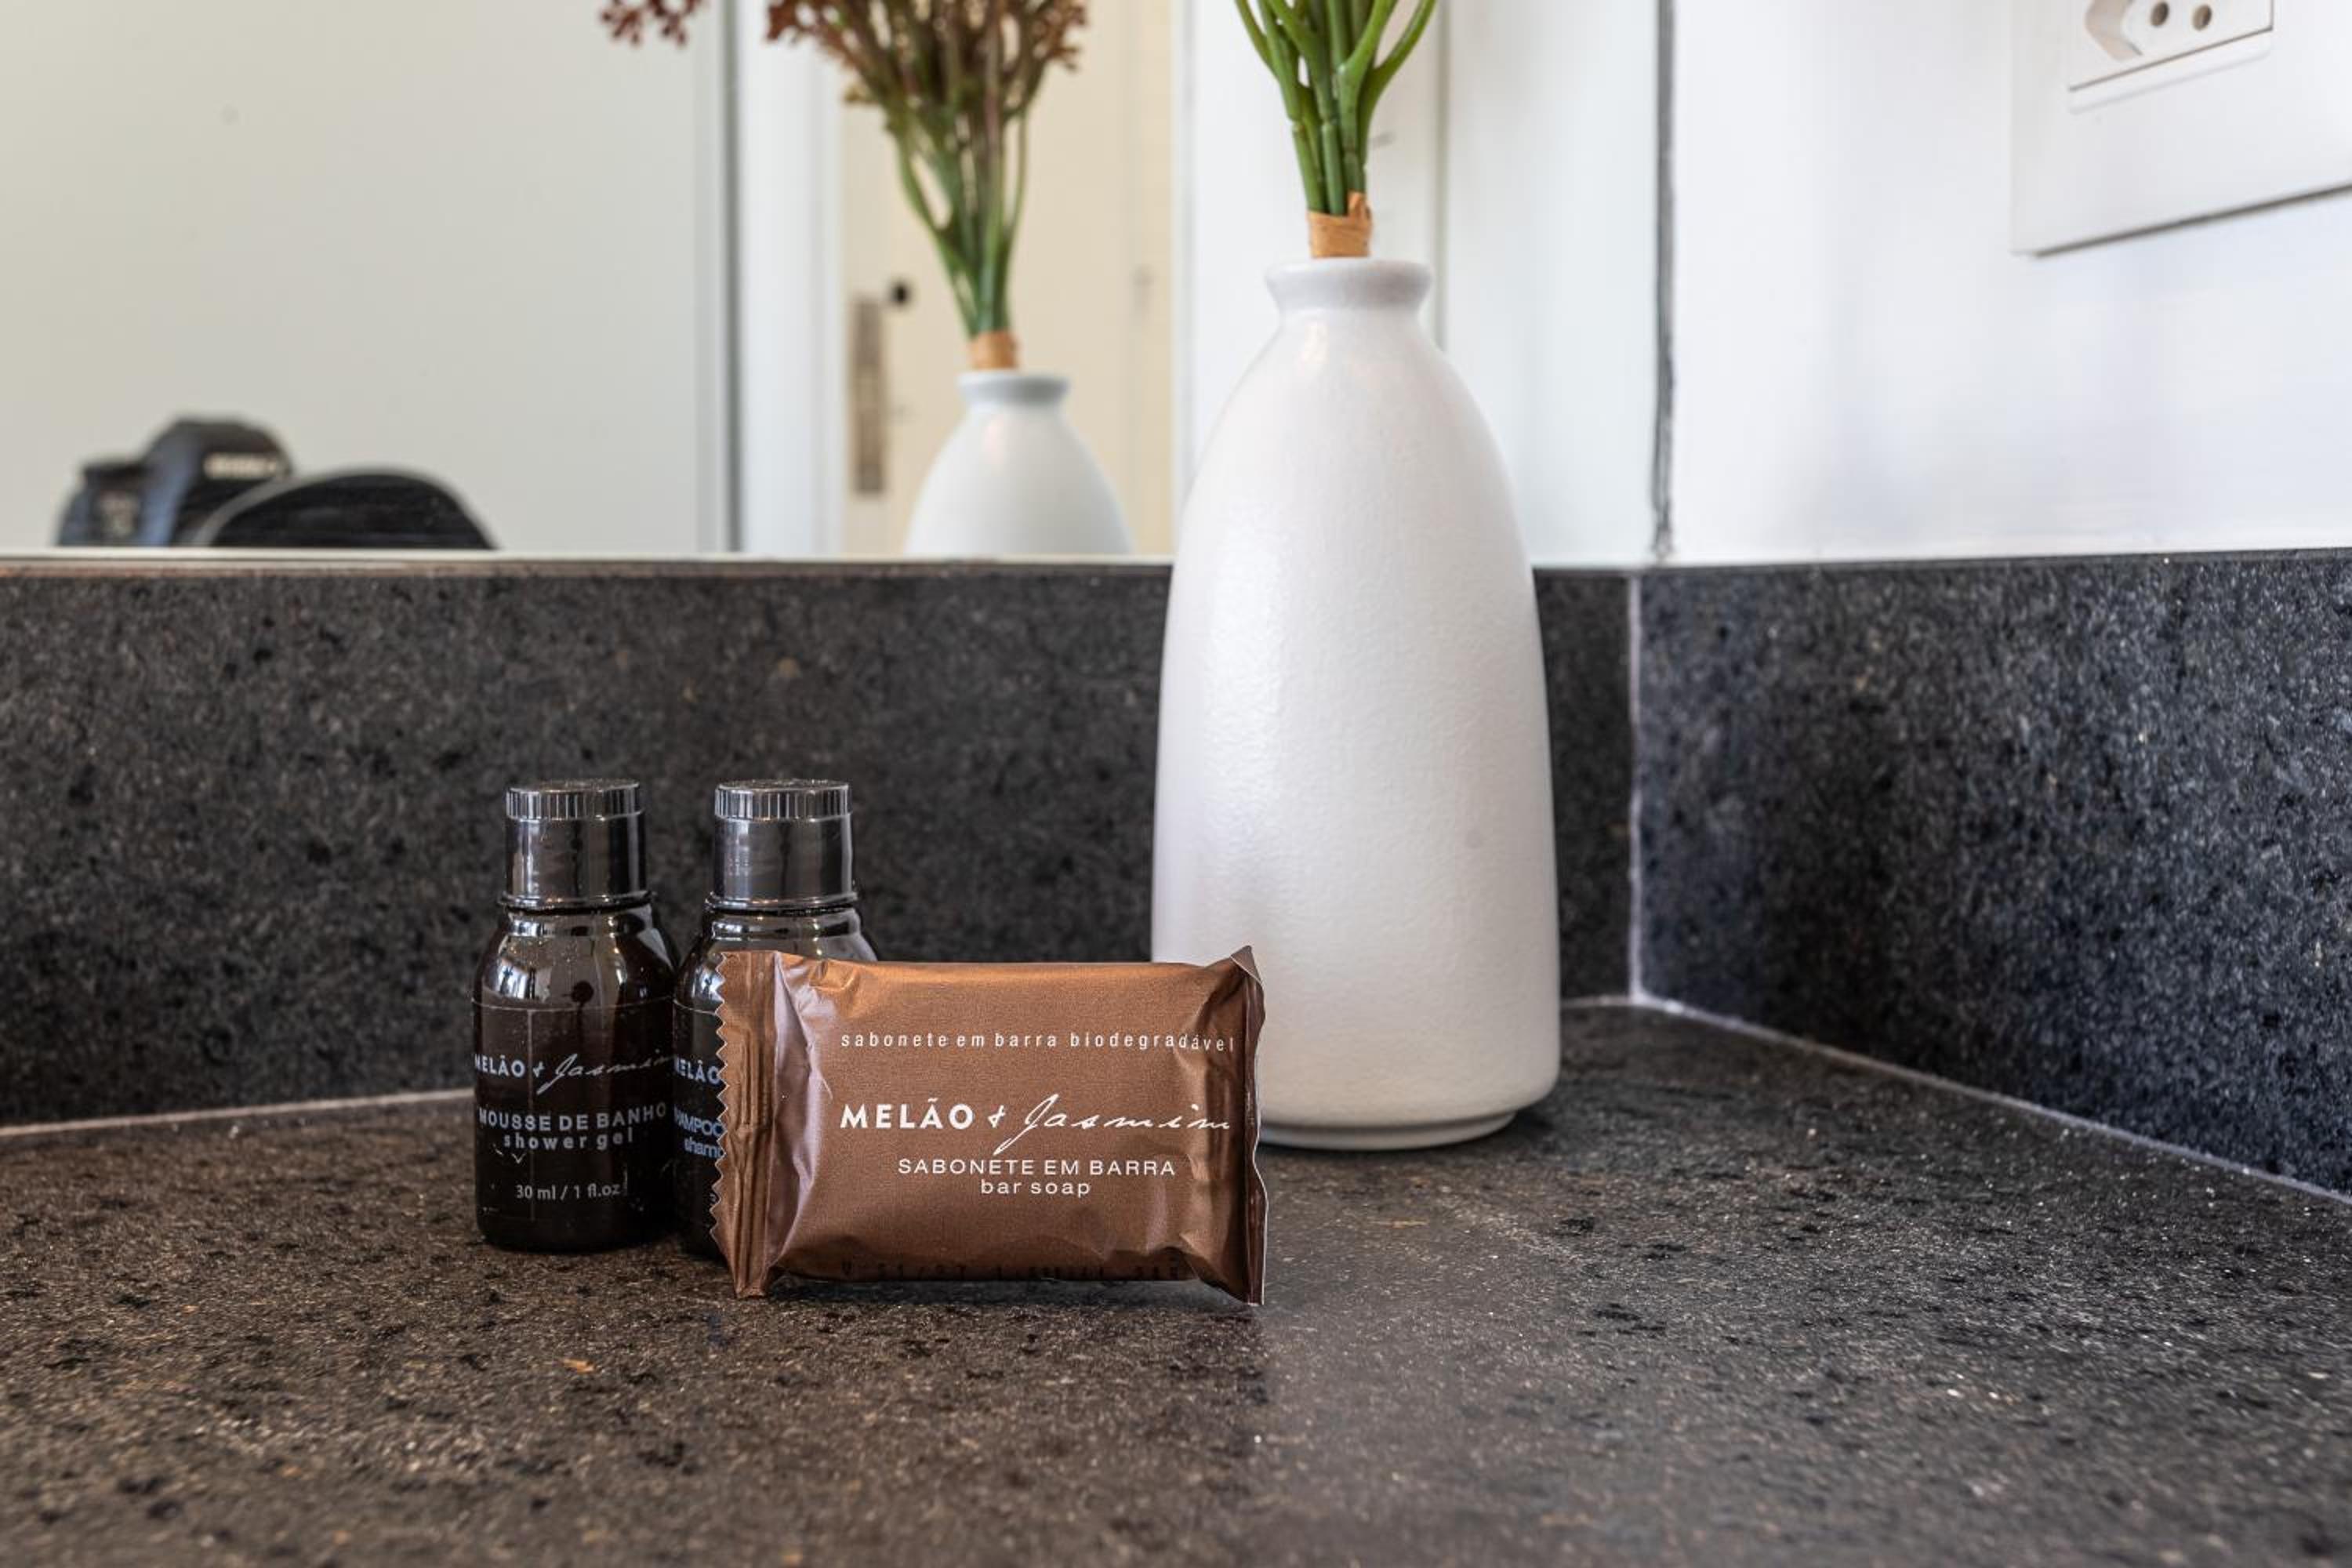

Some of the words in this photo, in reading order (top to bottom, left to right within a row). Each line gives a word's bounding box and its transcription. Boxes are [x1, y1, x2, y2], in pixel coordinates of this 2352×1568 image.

[840, 1031, 949, 1048] sabonete
[956, 1034, 985, 1048] em
[994, 1032, 1058, 1048] barra
[1069, 1032, 1235, 1053] biodegradável
[479, 1107, 551, 1131] MOUSSE
[559, 1114, 589, 1131] DE
[597, 1102, 666, 1129] BANHO
[839, 1097, 975, 1130] MELÃO
[504, 1133, 587, 1150] shower
[597, 1127, 633, 1151] gel
[898, 1158, 1034, 1176] SABONETE
[1044, 1159, 1080, 1176] EM
[1089, 1160, 1177, 1177] BARRA
[516, 1185, 532, 1199] 30
[537, 1185, 556, 1200] ml
[560, 1185, 568, 1200] /
[573, 1185, 580, 1199] 1
[980, 1178, 1022, 1195] bar
[1030, 1181, 1091, 1199] soap
